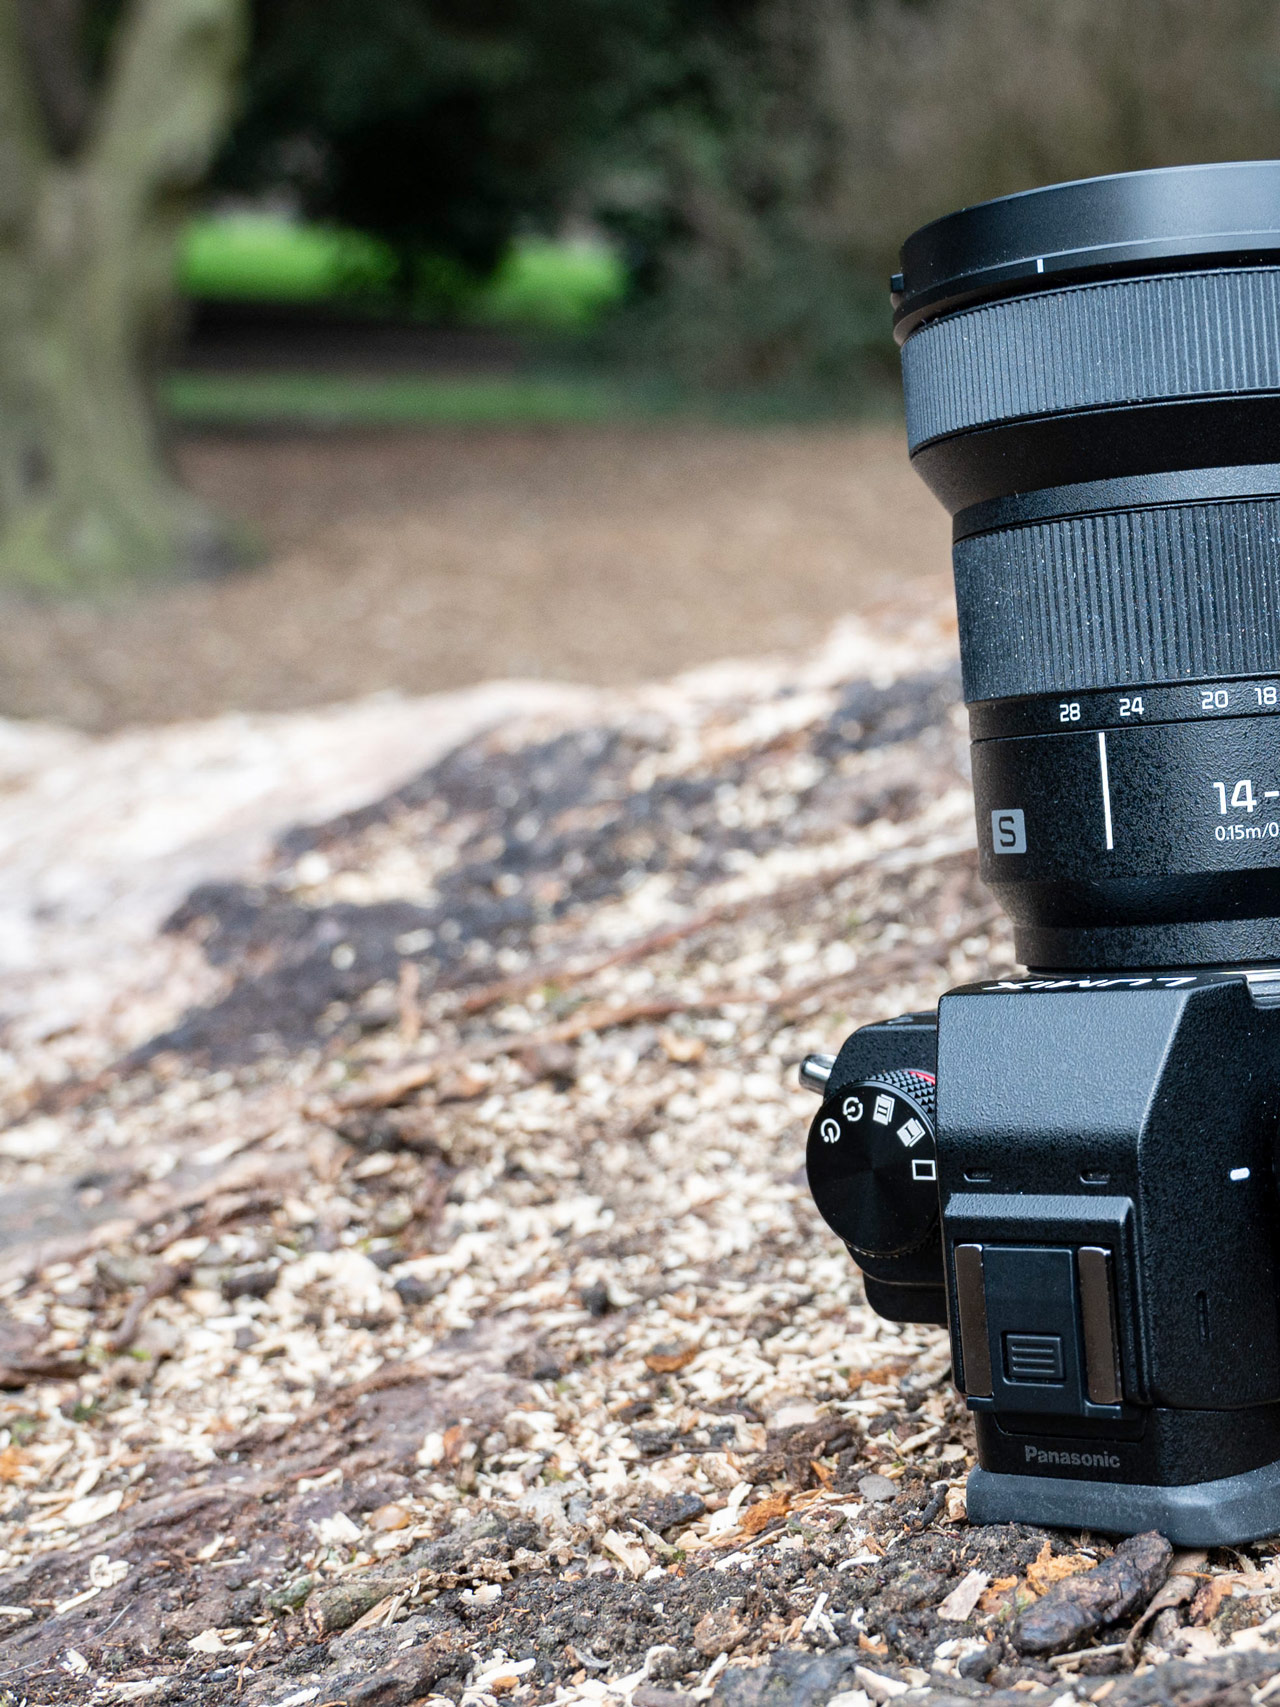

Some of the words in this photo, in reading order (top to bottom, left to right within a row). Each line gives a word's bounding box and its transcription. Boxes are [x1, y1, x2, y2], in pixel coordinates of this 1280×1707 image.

[1059, 702, 1081, 722] 28
[1118, 697, 1145, 716] 24
[1201, 690, 1229, 709] 20
[1254, 687, 1278, 706] 18
[998, 814, 1017, 848] S
[1024, 1444, 1121, 1468] Panasonic
